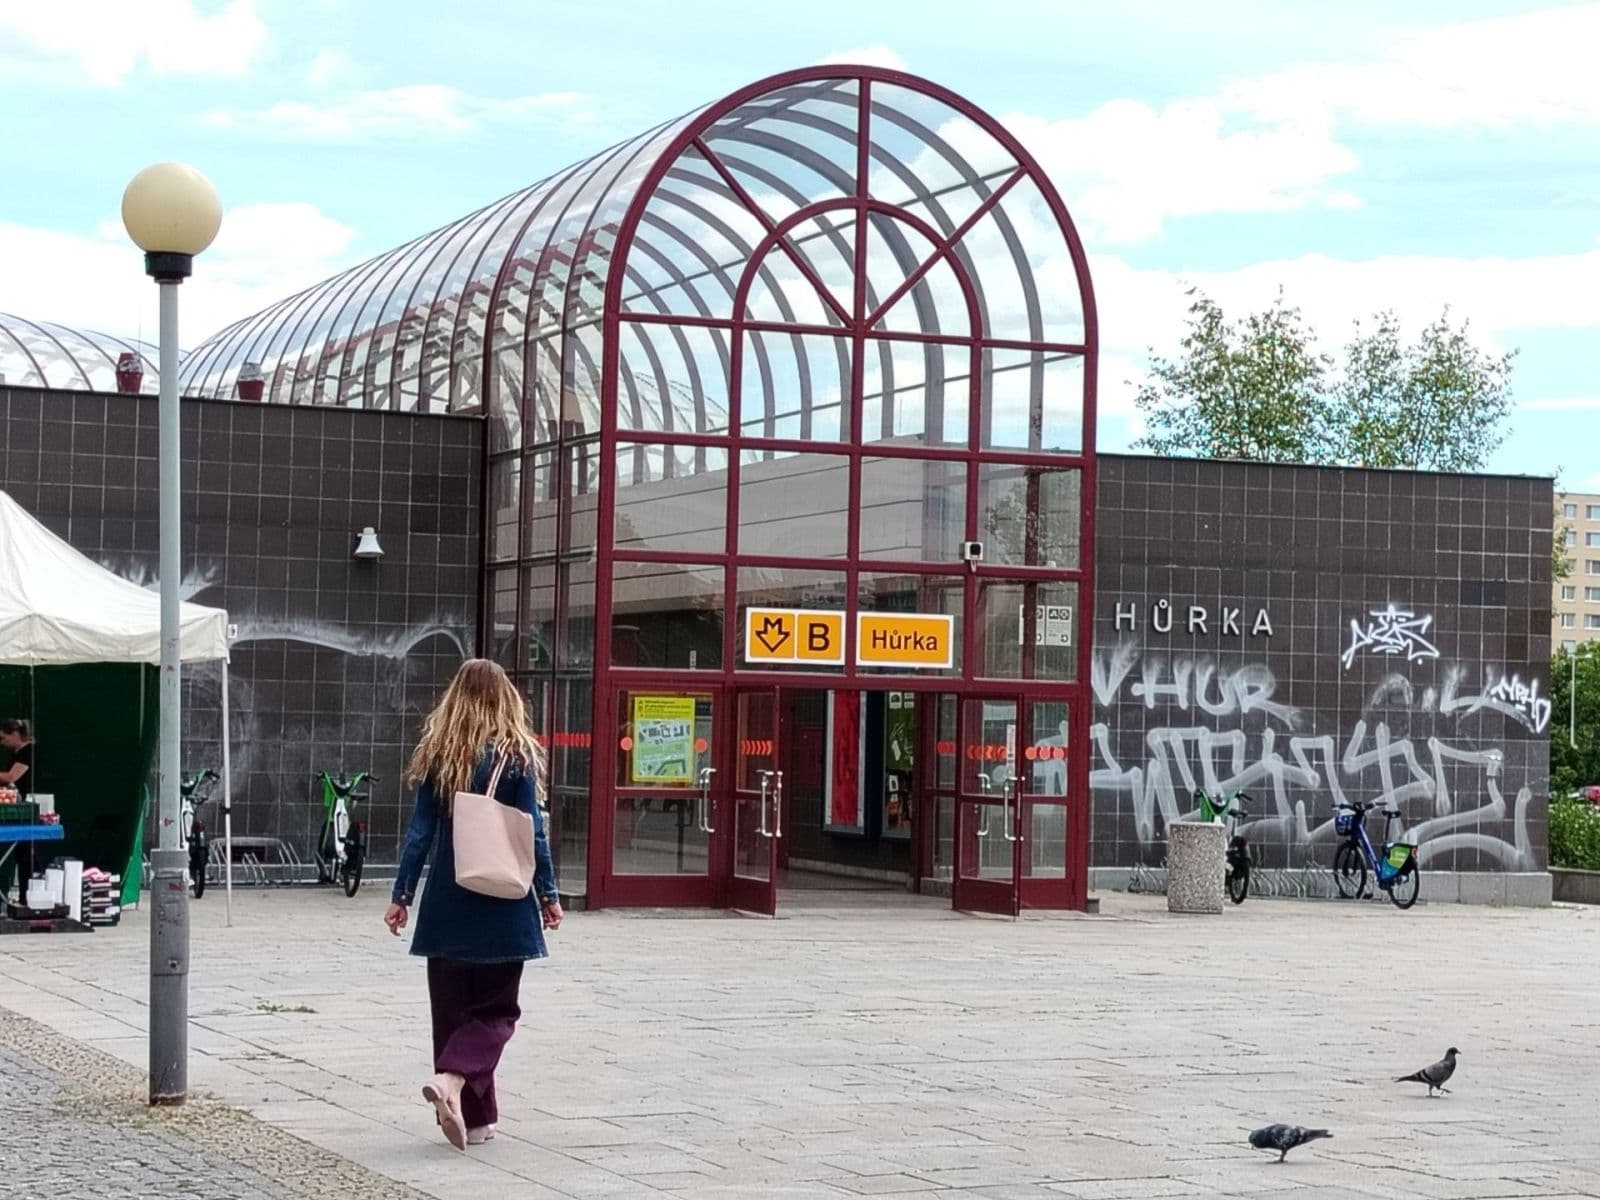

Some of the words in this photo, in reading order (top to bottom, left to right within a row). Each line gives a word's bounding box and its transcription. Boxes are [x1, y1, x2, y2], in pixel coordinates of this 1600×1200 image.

[1115, 599, 1273, 636] HŮRKA
[808, 623, 830, 651] B
[872, 629, 938, 651] Hůrka
